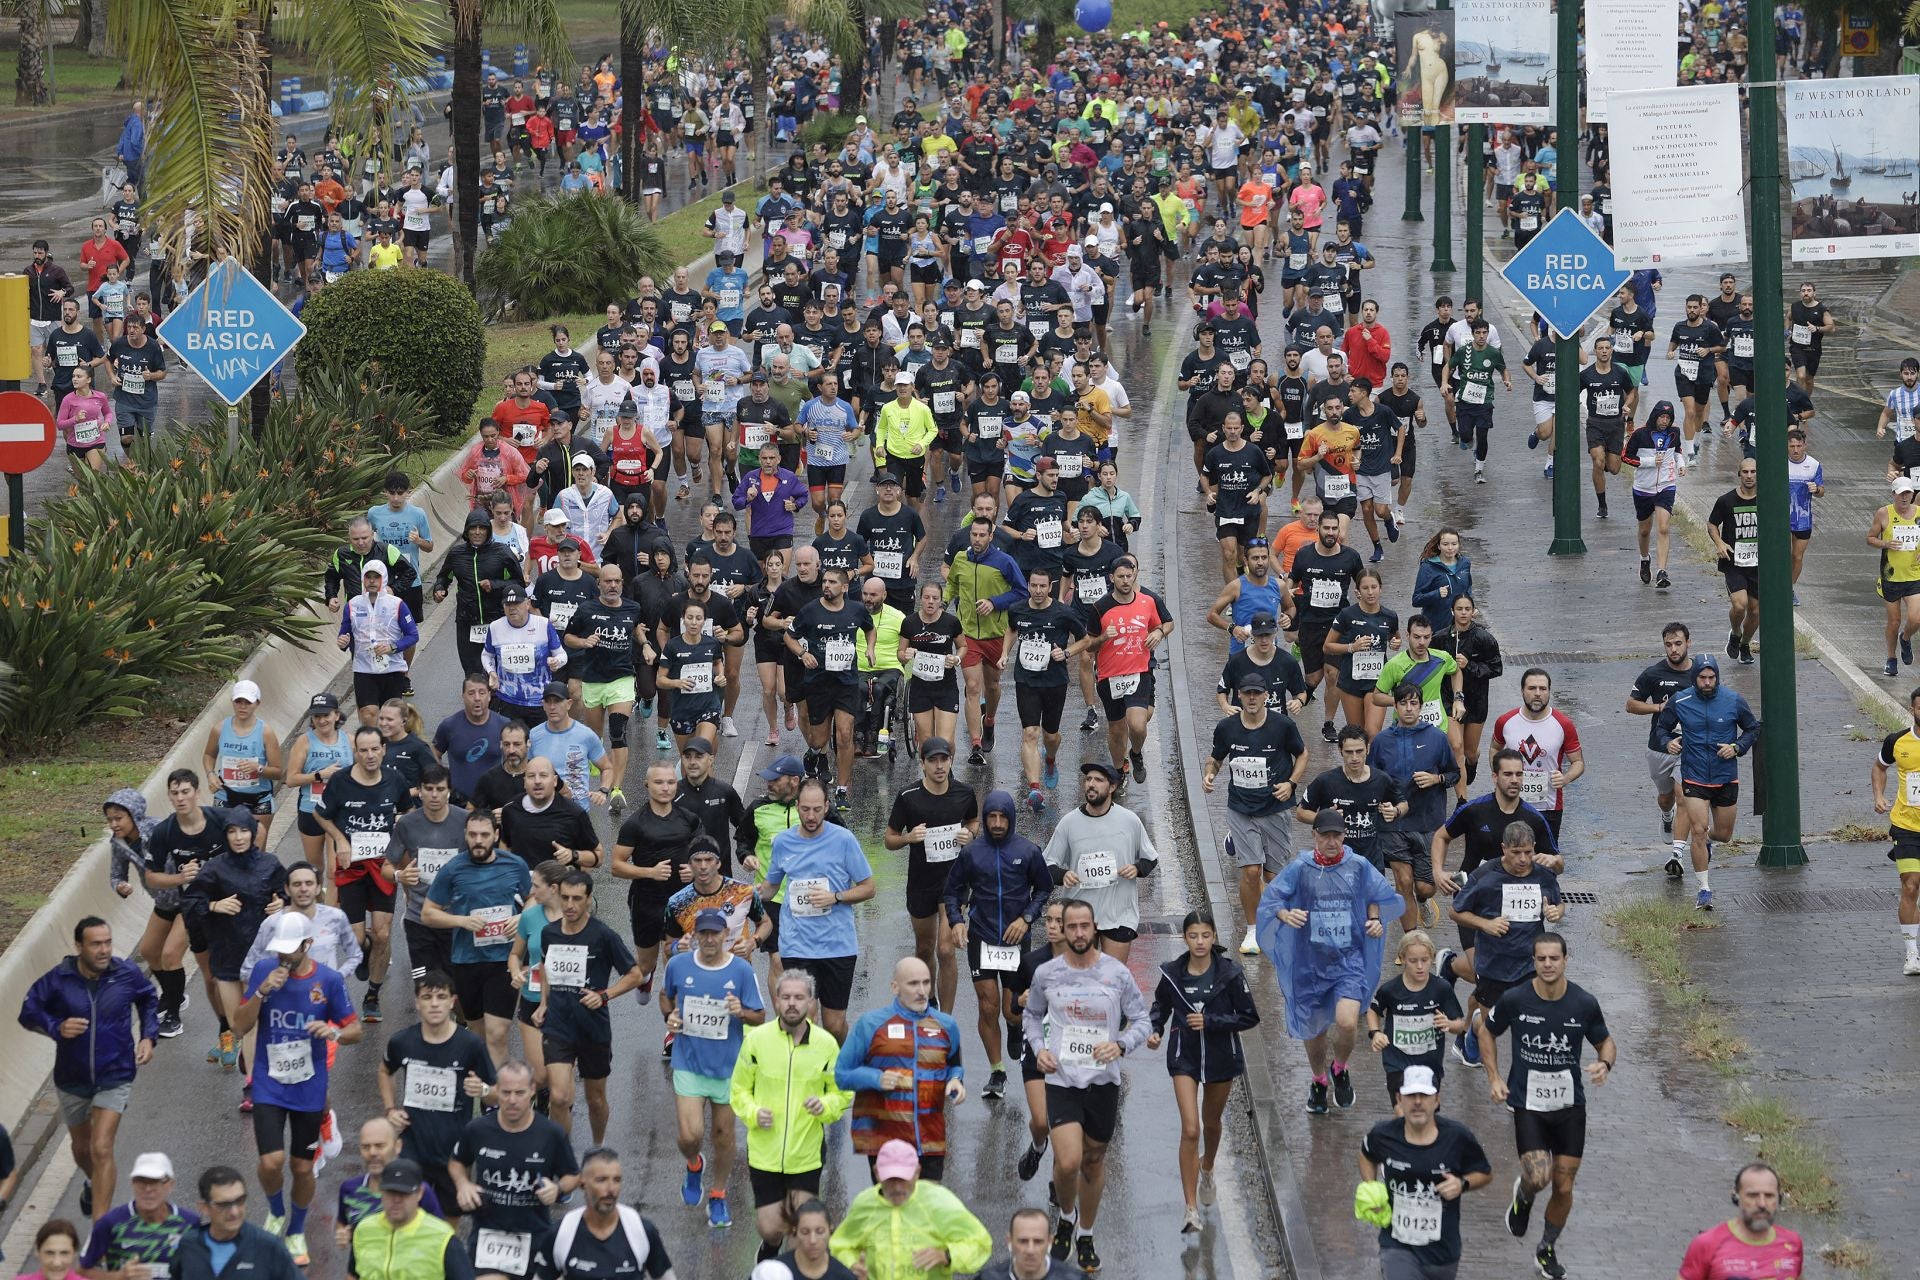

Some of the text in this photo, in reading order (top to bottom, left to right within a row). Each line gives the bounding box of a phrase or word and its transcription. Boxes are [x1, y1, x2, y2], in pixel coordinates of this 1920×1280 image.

[1471, 0, 1546, 8] WESTMORLAND
[1472, 13, 1512, 22] MÁLAGA
[1851, 20, 1869, 28] TAXI
[1795, 87, 1912, 101] El WESTMORLAND
[1795, 108, 1865, 120] en MÁLAGA
[1651, 132, 1699, 140] ESCULTURAS
[1632, 144, 1659, 152] LIBROS
[1667, 141, 1718, 149] DOCUMENTOS
[1656, 152, 1696, 160] GRABADOS
[1643, 170, 1711, 180] OBRAS MUSICALES
[1620, 213, 1739, 229] 19.09.2024 12.01.2025
[1545, 254, 1588, 270] RED
[1526, 271, 1606, 290] BÁSICA
[207, 310, 255, 328] RED
[187, 328, 276, 350] BÁSICA
[1466, 371, 1488, 380] GAES
[931, 379, 953, 387] mayoral
[707, 388, 721, 396] 1447
[1327, 483, 1348, 491] 13803
[1041, 531, 1062, 541] 10332
[877, 562, 899, 571] 10492
[1083, 587, 1104, 598] 7248
[1314, 591, 1339, 600] 11308
[507, 655, 530, 664] 1399
[1024, 652, 1045, 662] 7247
[919, 663, 940, 673] 3903
[1355, 662, 1382, 671] 12930
[1116, 680, 1135, 692] 656
[223, 742, 249, 752] nerja
[311, 750, 342, 761] nerja
[1236, 768, 1264, 779] 11841
[933, 838, 958, 852] 1086
[357, 845, 386, 857] 3914
[1084, 866, 1111, 878] 1085
[1510, 899, 1537, 909] 1153
[1318, 926, 1346, 938] 6614
[987, 951, 1015, 961] 7437
[552, 962, 581, 974] 3802
[688, 1013, 726, 1027] 11297
[1397, 1031, 1434, 1045] 21022
[276, 1056, 306, 1073] 3969
[414, 1082, 448, 1098] 3803
[1535, 1087, 1567, 1099] 5317
[1397, 1213, 1438, 1231] 10123
[487, 1243, 522, 1259] 6778
